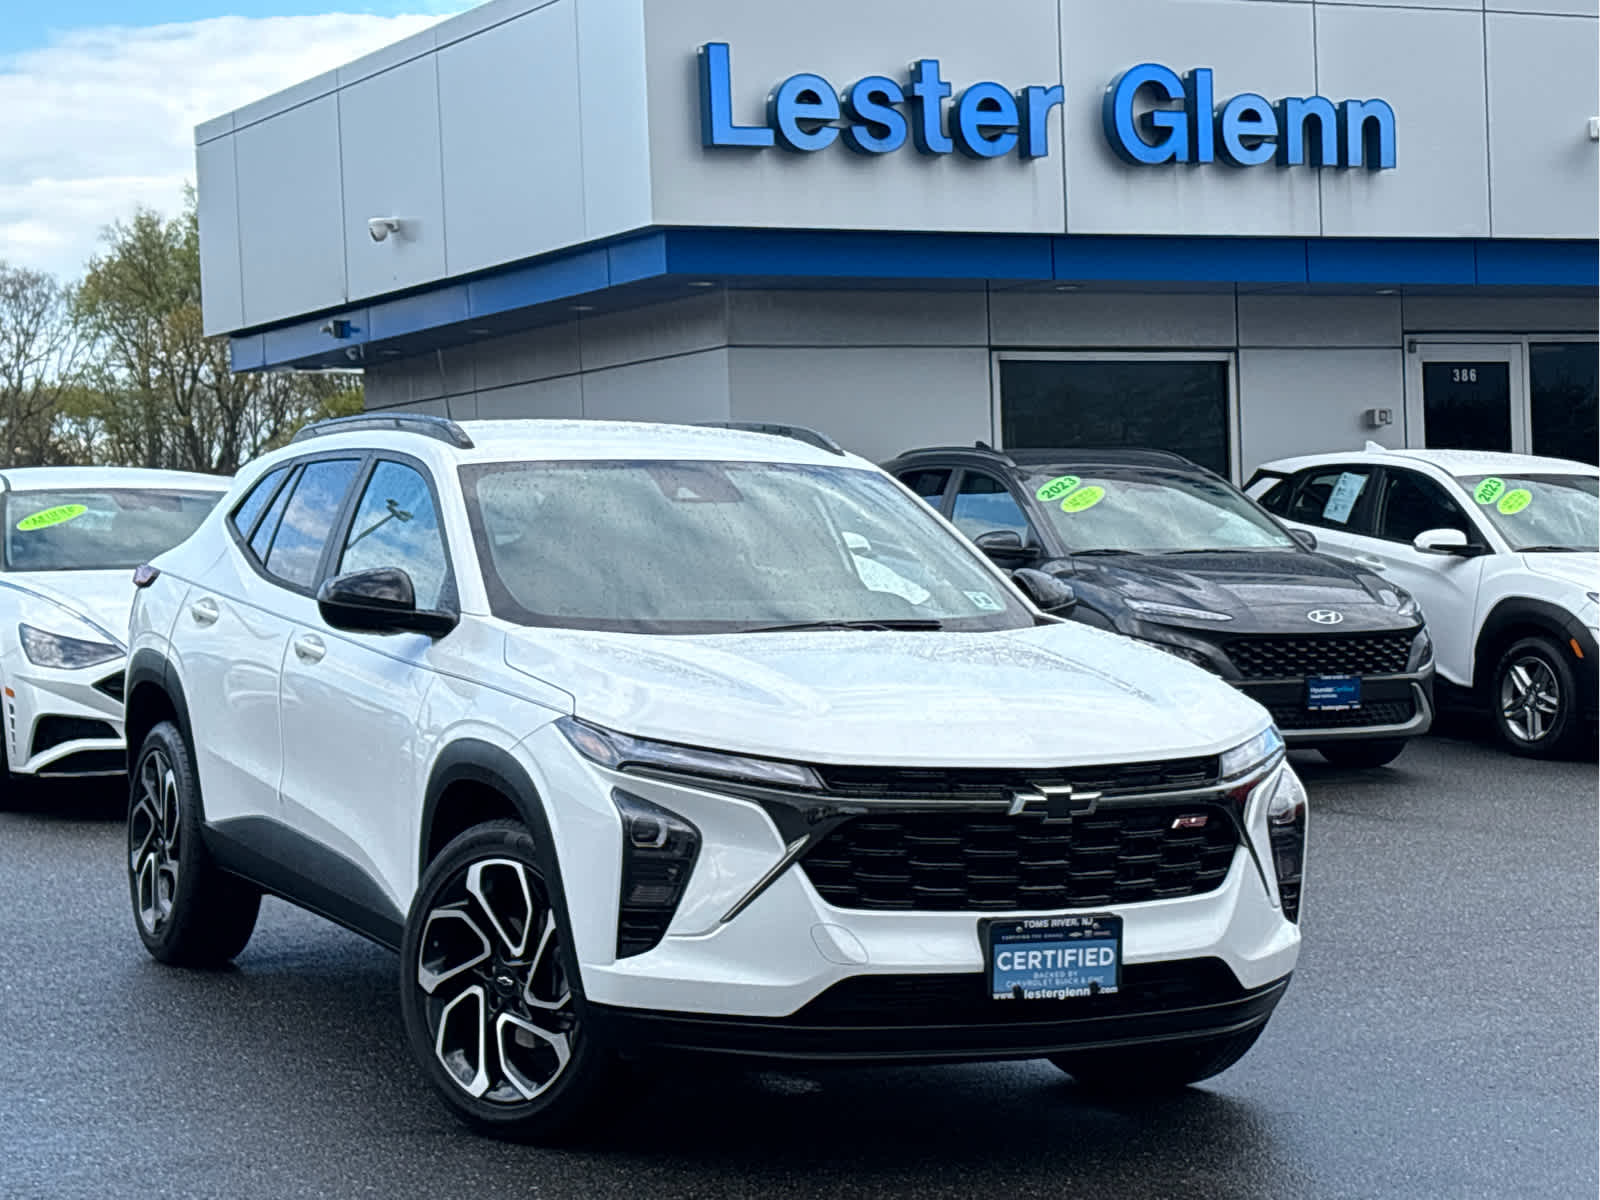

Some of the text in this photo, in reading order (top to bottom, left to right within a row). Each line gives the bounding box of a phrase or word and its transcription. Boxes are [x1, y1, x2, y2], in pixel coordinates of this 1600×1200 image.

[699, 42, 1396, 169] Lester Glenn
[1453, 368, 1477, 382] 386
[1041, 477, 1077, 499] 2023
[1478, 479, 1502, 502] 2023
[1023, 919, 1049, 929] TOMS
[1081, 917, 1094, 926] NJ
[996, 947, 1115, 971] CERTIFIED
[1023, 988, 1091, 1000] lesterglenn
